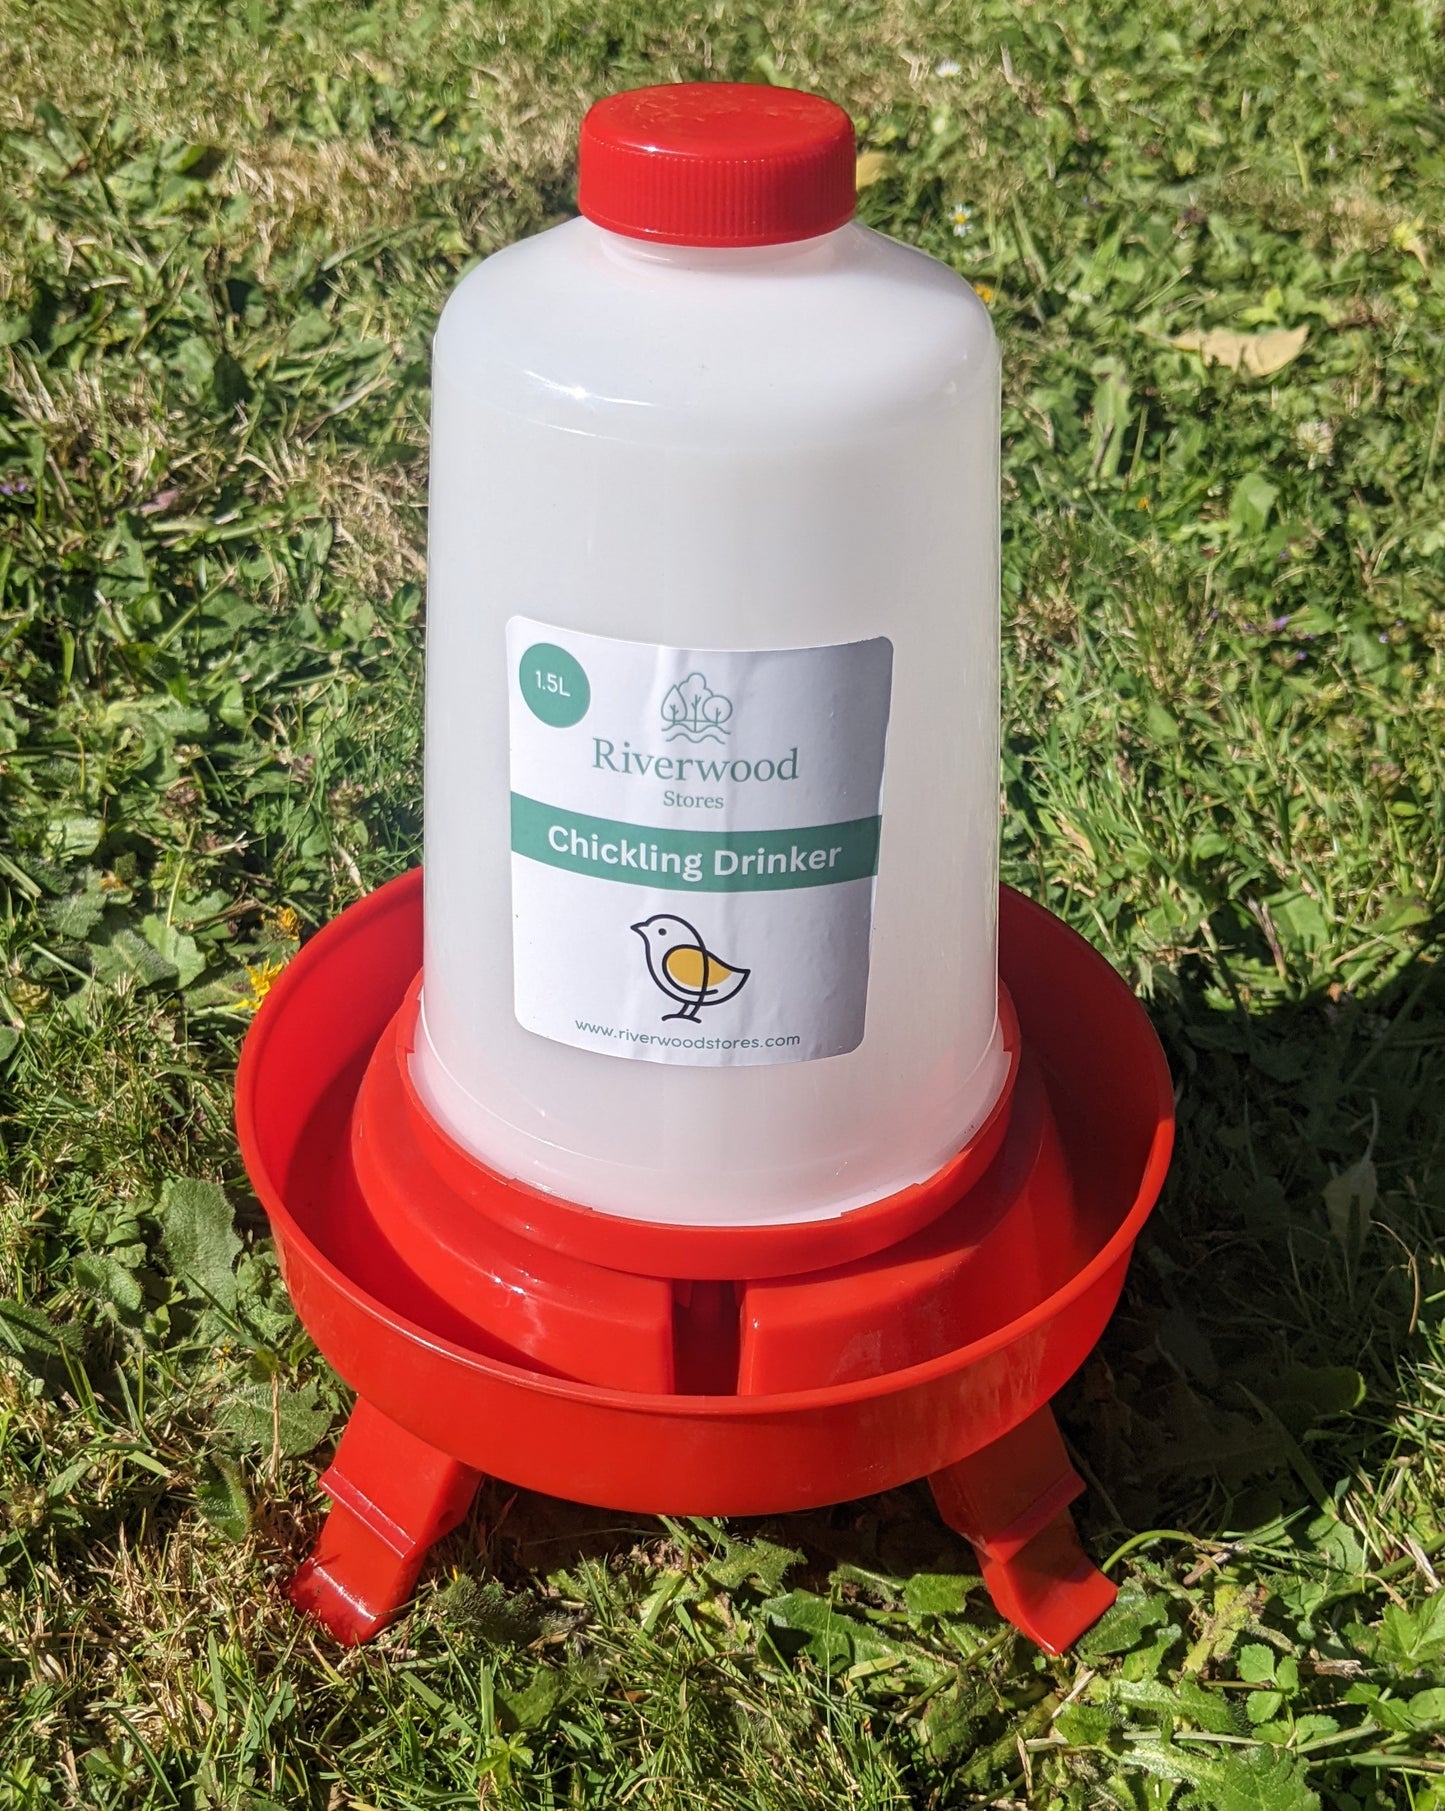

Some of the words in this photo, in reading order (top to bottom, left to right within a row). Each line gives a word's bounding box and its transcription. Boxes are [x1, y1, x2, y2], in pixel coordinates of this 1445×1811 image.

[535, 669, 571, 697] 1.5L
[592, 738, 799, 783] Riverwood
[663, 791, 724, 809] Stores
[548, 825, 703, 882] Chickling
[714, 844, 842, 876] Drinker
[575, 1018, 800, 1050] www.riverwoodstores.com
